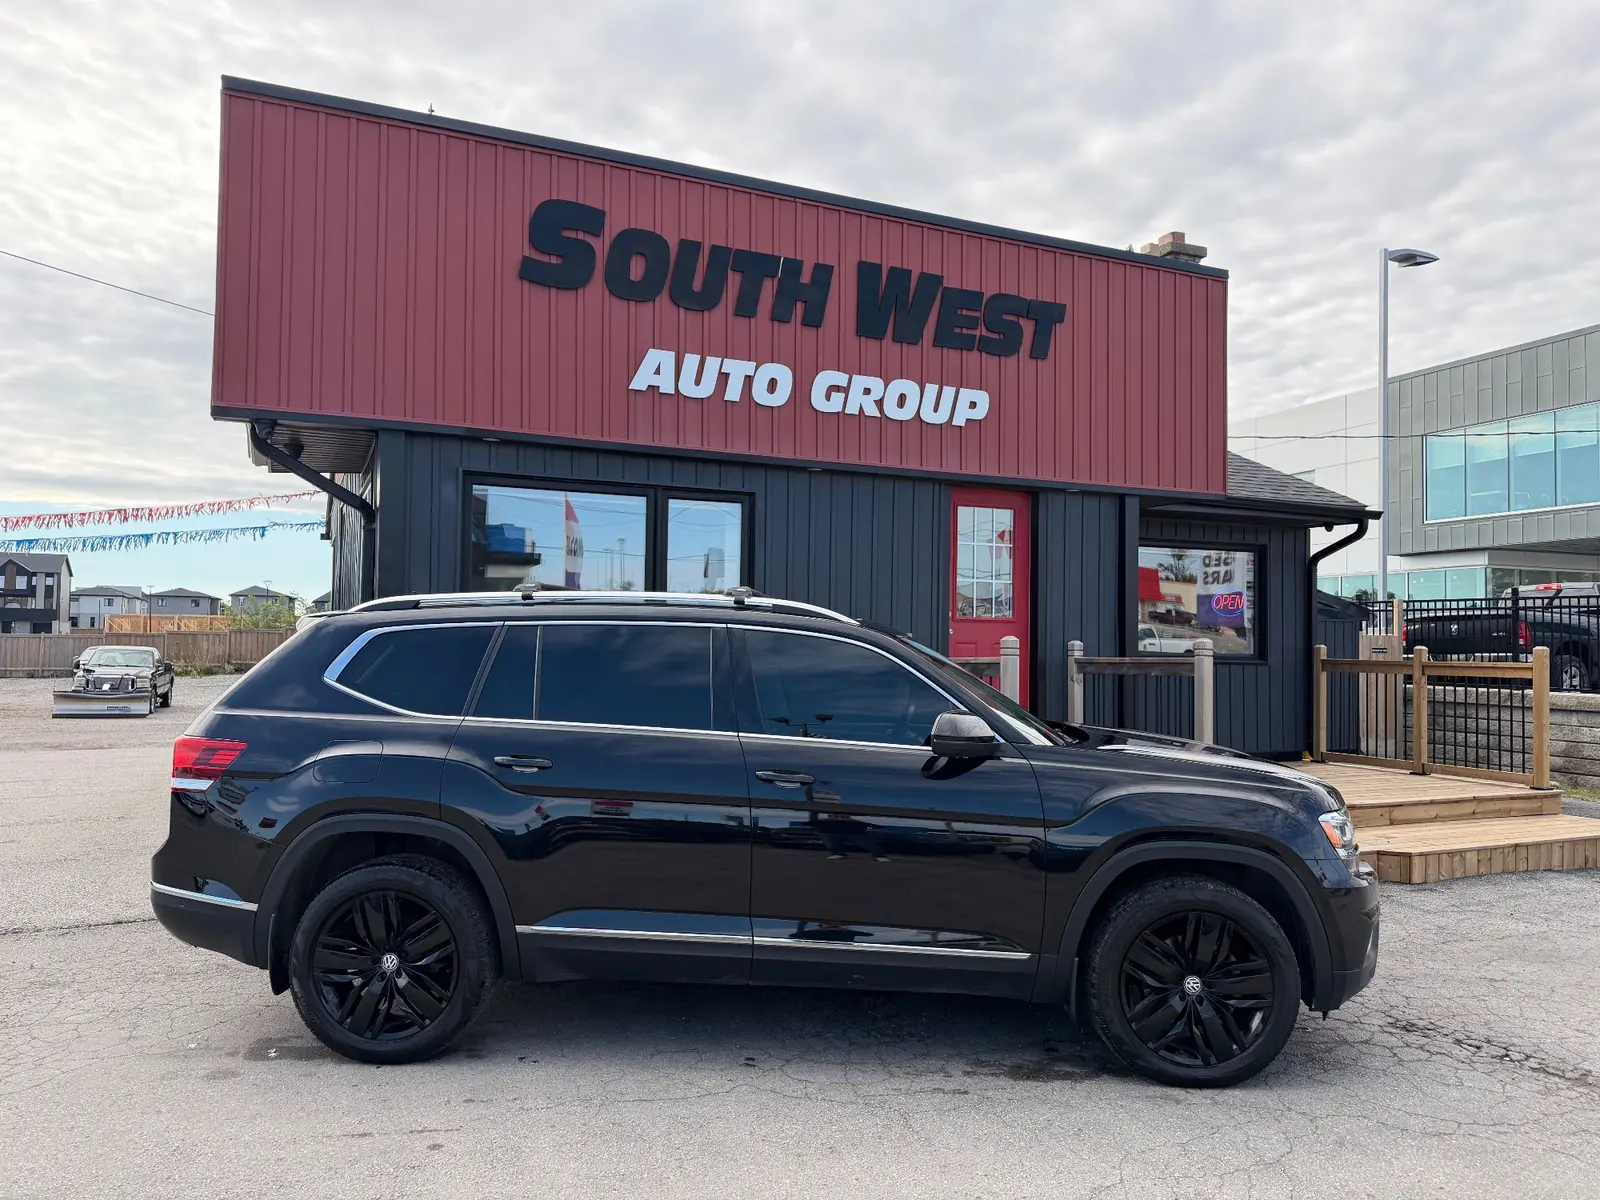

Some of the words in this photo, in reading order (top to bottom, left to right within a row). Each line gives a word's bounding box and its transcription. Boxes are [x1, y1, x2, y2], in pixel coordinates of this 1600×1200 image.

[519, 198, 835, 328] SOUTH
[857, 260, 1067, 360] WEST
[628, 348, 793, 408] AUTO
[810, 369, 990, 427] GROUP
[1213, 594, 1245, 610] OPEN
